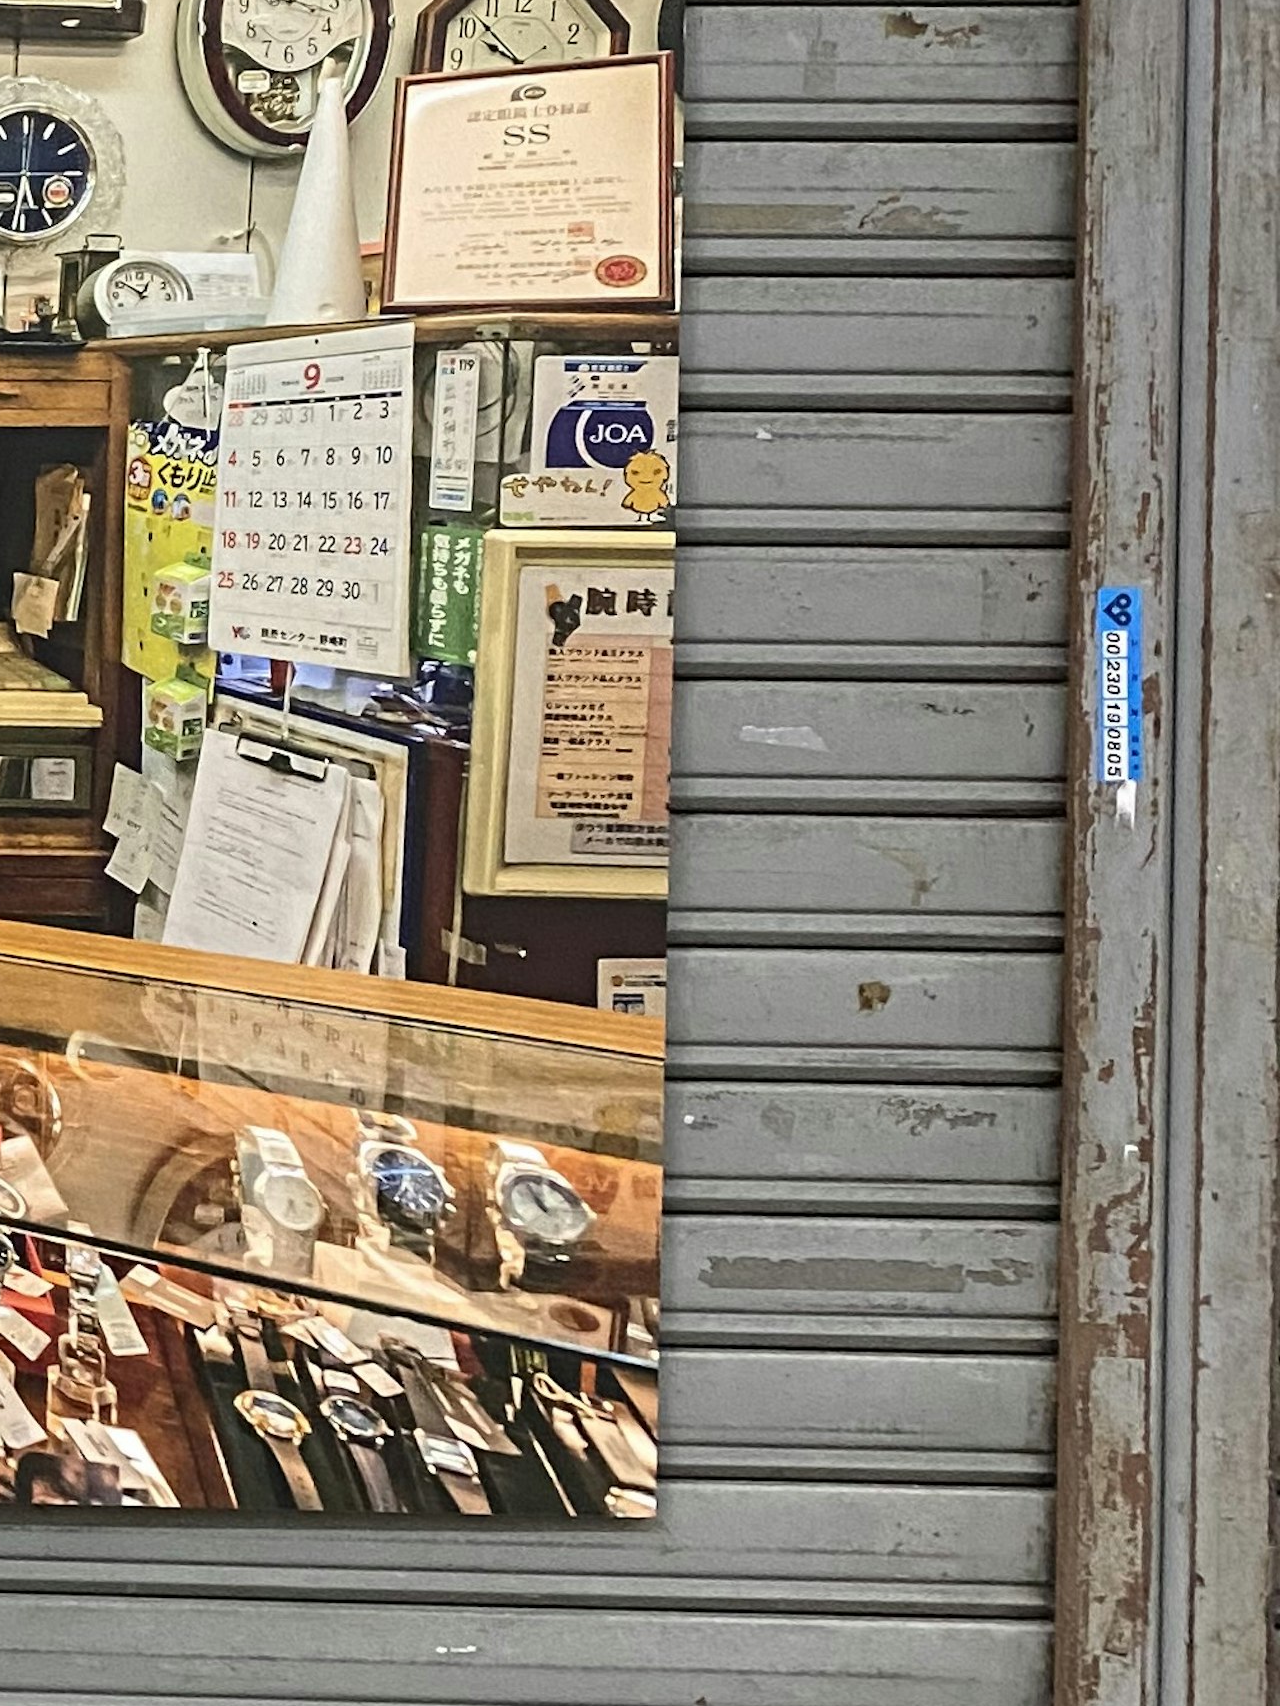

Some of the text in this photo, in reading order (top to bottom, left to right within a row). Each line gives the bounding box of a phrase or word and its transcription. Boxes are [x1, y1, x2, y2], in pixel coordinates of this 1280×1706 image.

[246, 21, 256, 38] 8
[322, 17, 331, 34] 4
[262, 40, 272, 58] 7
[284, 45, 294, 63] 6
[307, 37, 317, 55] 5
[503, 124, 551, 146] SS
[304, 363, 321, 390] 9
[251, 410, 268, 425] 29
[275, 408, 292, 424] 30
[299, 406, 314, 422] 31
[329, 405, 335, 421] 1
[353, 402, 363, 420] 2
[379, 401, 389, 419] 3
[590, 424, 647, 443] JOA
[228, 446, 392, 467] 4 5 6 7 8 9 10
[224, 491, 390, 510] 11 12 13 14 15 16 17
[221, 531, 389, 556] 18 19 20 21 22 23 24
[217, 571, 235, 589] 25
[242, 573, 259, 590] 26
[266, 575, 284, 592] 27
[290, 577, 308, 595] 28
[316, 578, 334, 597] 29
[341, 581, 360, 600] 30
[586, 587, 673, 617] 腕時
[1106, 631, 1122, 778] 00 230 19 0805
